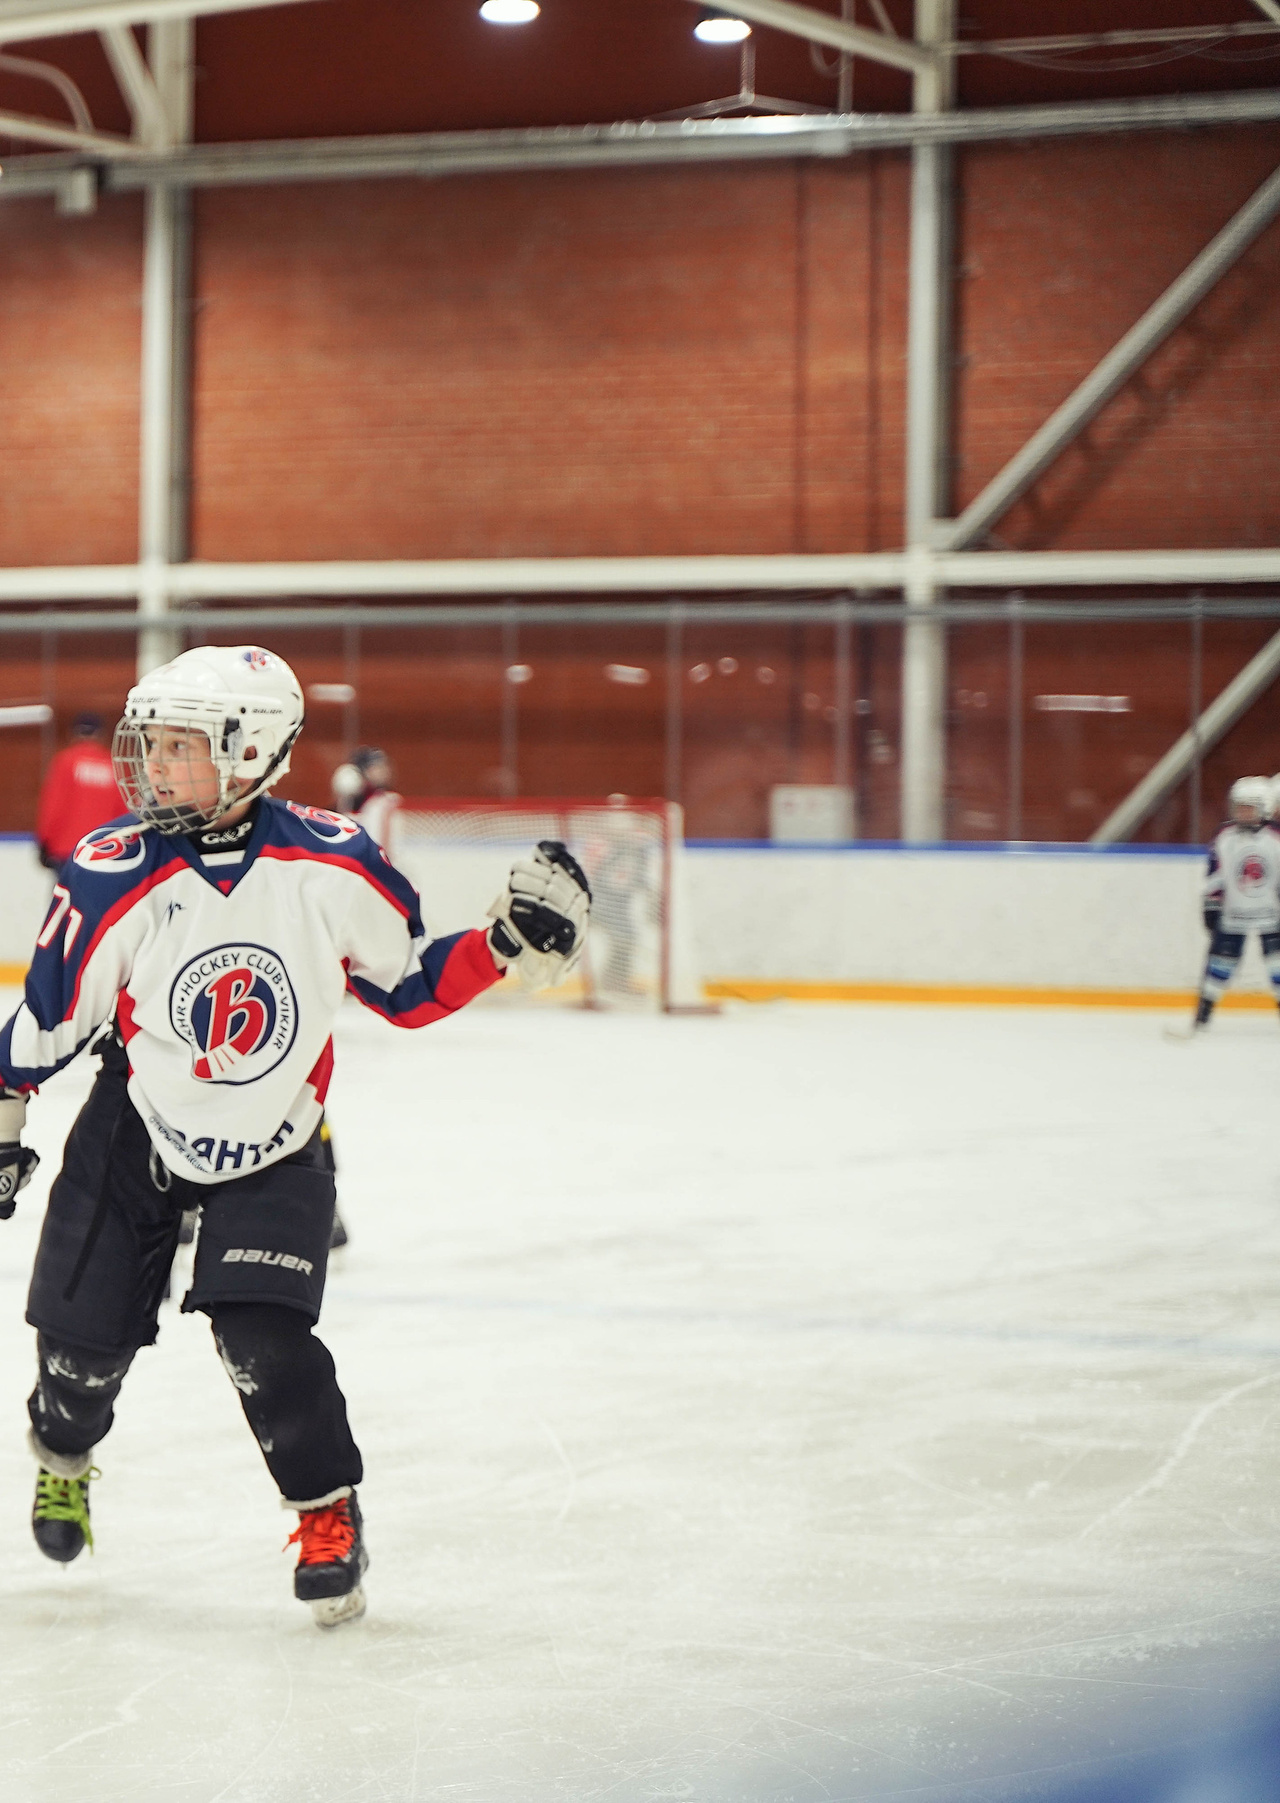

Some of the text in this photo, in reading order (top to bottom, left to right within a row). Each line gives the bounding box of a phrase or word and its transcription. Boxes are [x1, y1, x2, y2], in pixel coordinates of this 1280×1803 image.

[180, 952, 283, 997] HOCKEY CLUB
[273, 995, 290, 1051] VIKHR
[220, 1248, 314, 1276] BAUER
